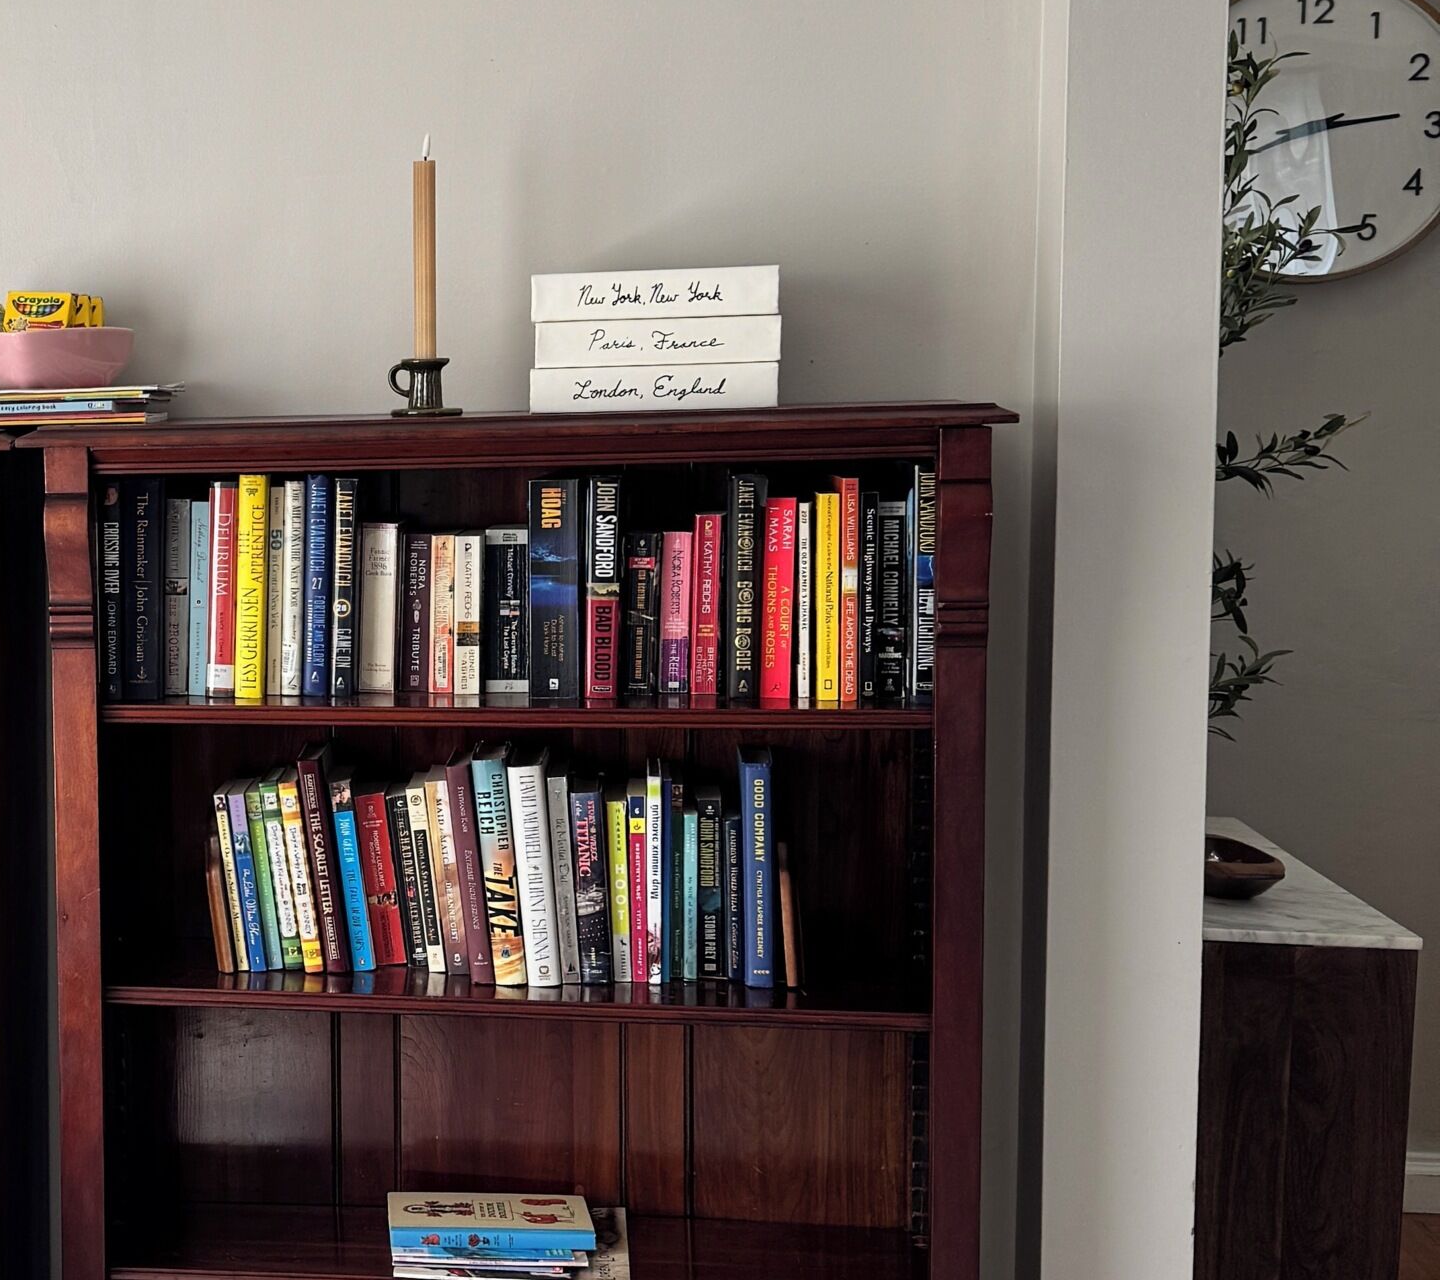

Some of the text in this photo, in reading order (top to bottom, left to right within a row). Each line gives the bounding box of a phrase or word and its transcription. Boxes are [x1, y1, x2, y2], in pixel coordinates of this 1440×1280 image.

[1237, 17, 1267, 44] 11
[1371, 11, 1380, 39] 1
[1408, 53, 1430, 81] 2
[1424, 111, 1440, 138] 3
[1402, 168, 1424, 196] 4
[1356, 214, 1377, 241] 5
[17, 296, 61, 305] Crayola
[578, 284, 605, 307] New
[650, 283, 679, 303] New
[688, 281, 723, 302] York
[651, 330, 725, 350] France
[653, 375, 726, 401] England
[310, 483, 326, 572] JANET EVANOVICH
[541, 487, 562, 529] HOAG
[594, 481, 618, 578] JOHN SANDFORD
[737, 480, 755, 572] JANET EVANOVICH
[782, 509, 793, 549] SARAH
[846, 493, 856, 561] LISA WILLIAMS
[136, 492, 149, 579] The Rainmaker
[216, 512, 232, 596] DELIRIUM
[251, 504, 265, 584] APPRENTICE
[271, 528, 283, 551] 50
[335, 489, 353, 587] JANET EVANOVICH
[768, 517, 779, 552] MAAS
[104, 522, 120, 594] CROSSING OVER
[409, 552, 419, 597] ROBERTS
[417, 559, 427, 590] NORA
[464, 561, 473, 589] KATHY
[703, 540, 713, 576] KATHY
[863, 508, 875, 653] Scenic Highways and Byways
[882, 519, 900, 625] MICHAEL CONNELLY
[312, 577, 322, 590] 27
[670, 550, 685, 615] NORA ROBERTS
[767, 565, 778, 613] THORNS
[780, 585, 790, 594] A
[824, 571, 834, 625] National Parks
[107, 600, 117, 675] JOHN EDWARD
[135, 585, 149, 662] John Grisham
[239, 588, 259, 692] TESS GERRITSEN
[313, 595, 326, 668] FORTUNE GLORY
[735, 580, 755, 671] GOING ROGUE
[779, 597, 790, 638] COURT
[335, 628, 352, 668] GAME ON
[411, 627, 421, 672] TRIBUTE
[594, 605, 612, 681] BAD BLOOD
[706, 647, 714, 682] BREAK
[765, 630, 776, 669] ROSES
[845, 596, 854, 695] LIFE AMONG THE DEAD
[669, 656, 680, 676] REEF
[309, 811, 322, 832] THE
[339, 818, 351, 836] JOHN
[477, 792, 494, 835] REICH
[491, 773, 509, 851] CHRISTOPHER
[753, 778, 765, 862] GOOD COMPANY
[312, 833, 328, 877] SCARLET
[343, 838, 355, 863] GREEN
[399, 830, 415, 882] SHADOWS
[417, 833, 431, 897] NICHOLAS SPARKS
[576, 817, 591, 877] TITANIC
[699, 817, 714, 887] JOHN SANDFORD
[318, 879, 333, 915] LETTER
[484, 862, 518, 938] THE TAKE
[614, 863, 626, 921] HOOT
[755, 869, 764, 958] CYNTHIA SWEENEY
[449, 922, 459, 942] GIST
[532, 918, 550, 962] SIENNA
[705, 914, 716, 960] STORM PREY
